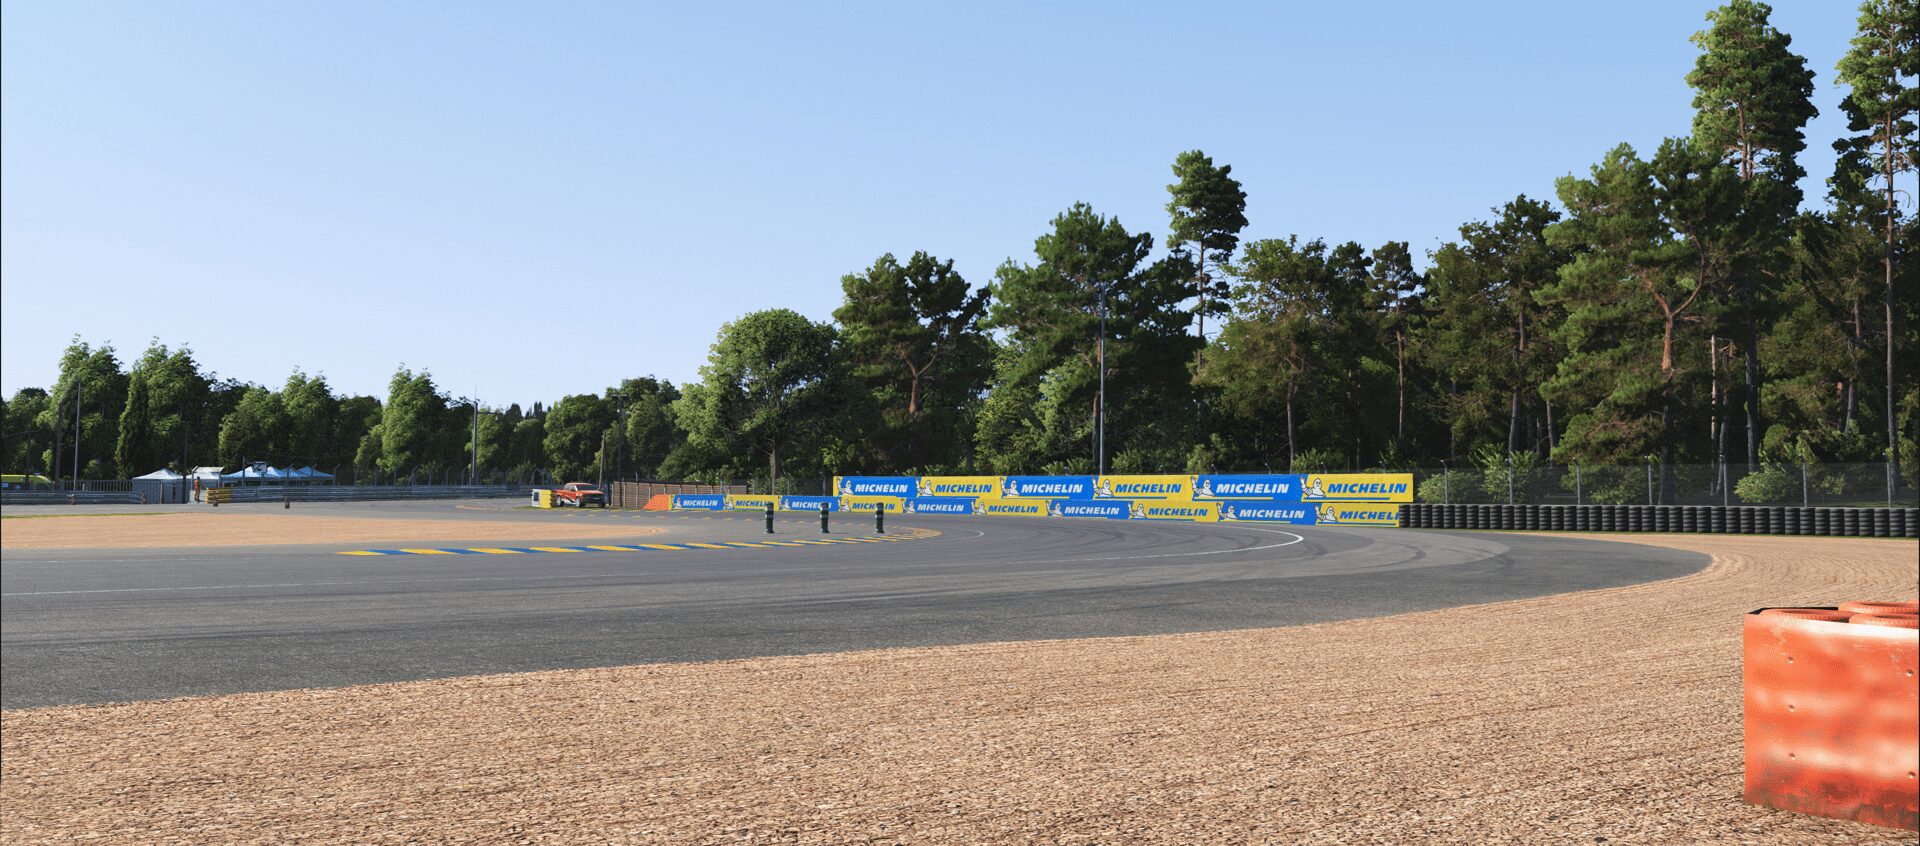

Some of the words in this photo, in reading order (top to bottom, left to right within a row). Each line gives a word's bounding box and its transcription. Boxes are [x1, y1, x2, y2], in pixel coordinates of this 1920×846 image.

[855, 484, 908, 493] MICHELIN
[936, 484, 992, 493] MICHELIN
[1022, 484, 1082, 494] MICHELIN
[1115, 484, 1181, 493] MICHELIN
[1216, 484, 1289, 493] MICHELIN
[1328, 483, 1407, 493] MICHELIN
[917, 503, 964, 512] MICHELIN
[988, 505, 1038, 513] MICHELIN
[1064, 506, 1120, 515] MICHELIN
[1148, 508, 1208, 517] MICHELIN
[1239, 509, 1305, 519] MICHELIN
[1339, 510, 1400, 520] MICHELI
